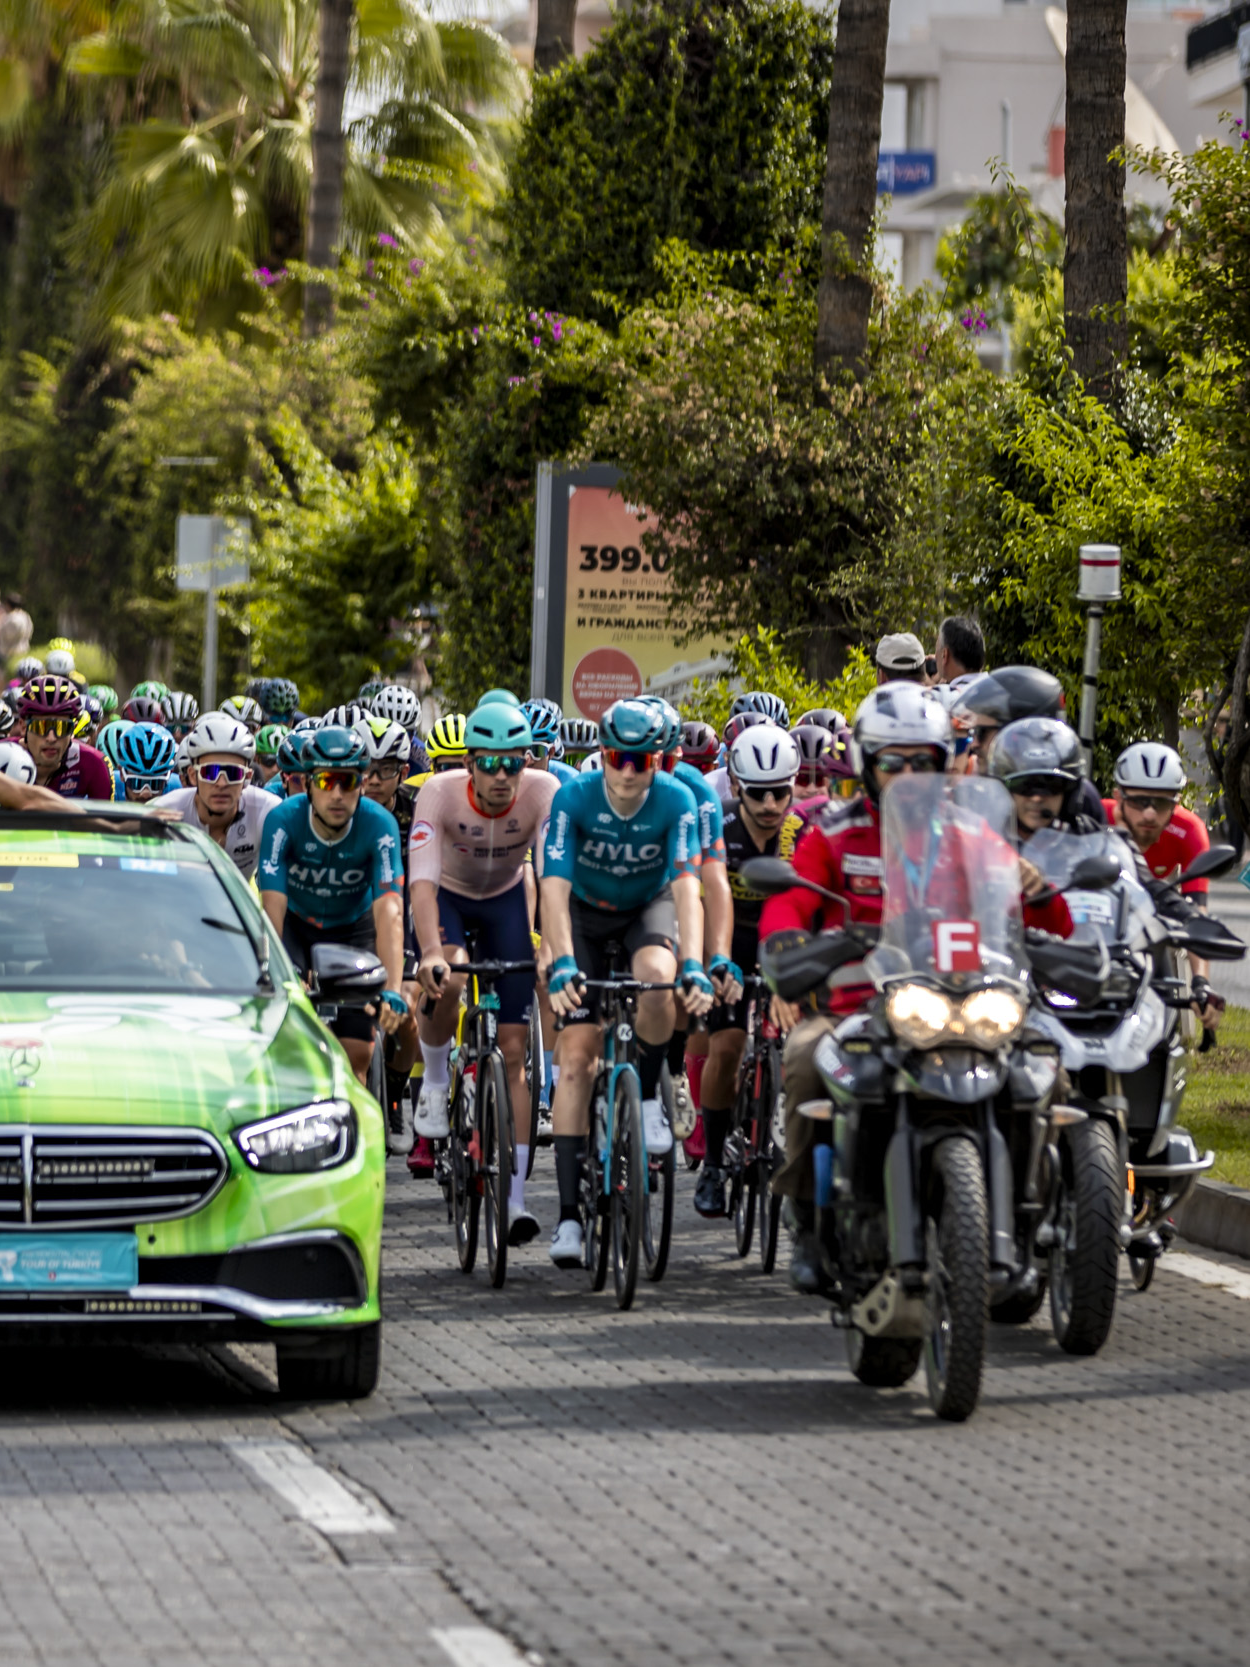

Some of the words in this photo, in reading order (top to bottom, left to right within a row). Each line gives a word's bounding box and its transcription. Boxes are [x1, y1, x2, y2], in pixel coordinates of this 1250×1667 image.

[580, 545, 671, 573] 399.0
[583, 839, 661, 862] HYLO
[289, 864, 365, 886] HYLO
[936, 922, 976, 972] F
